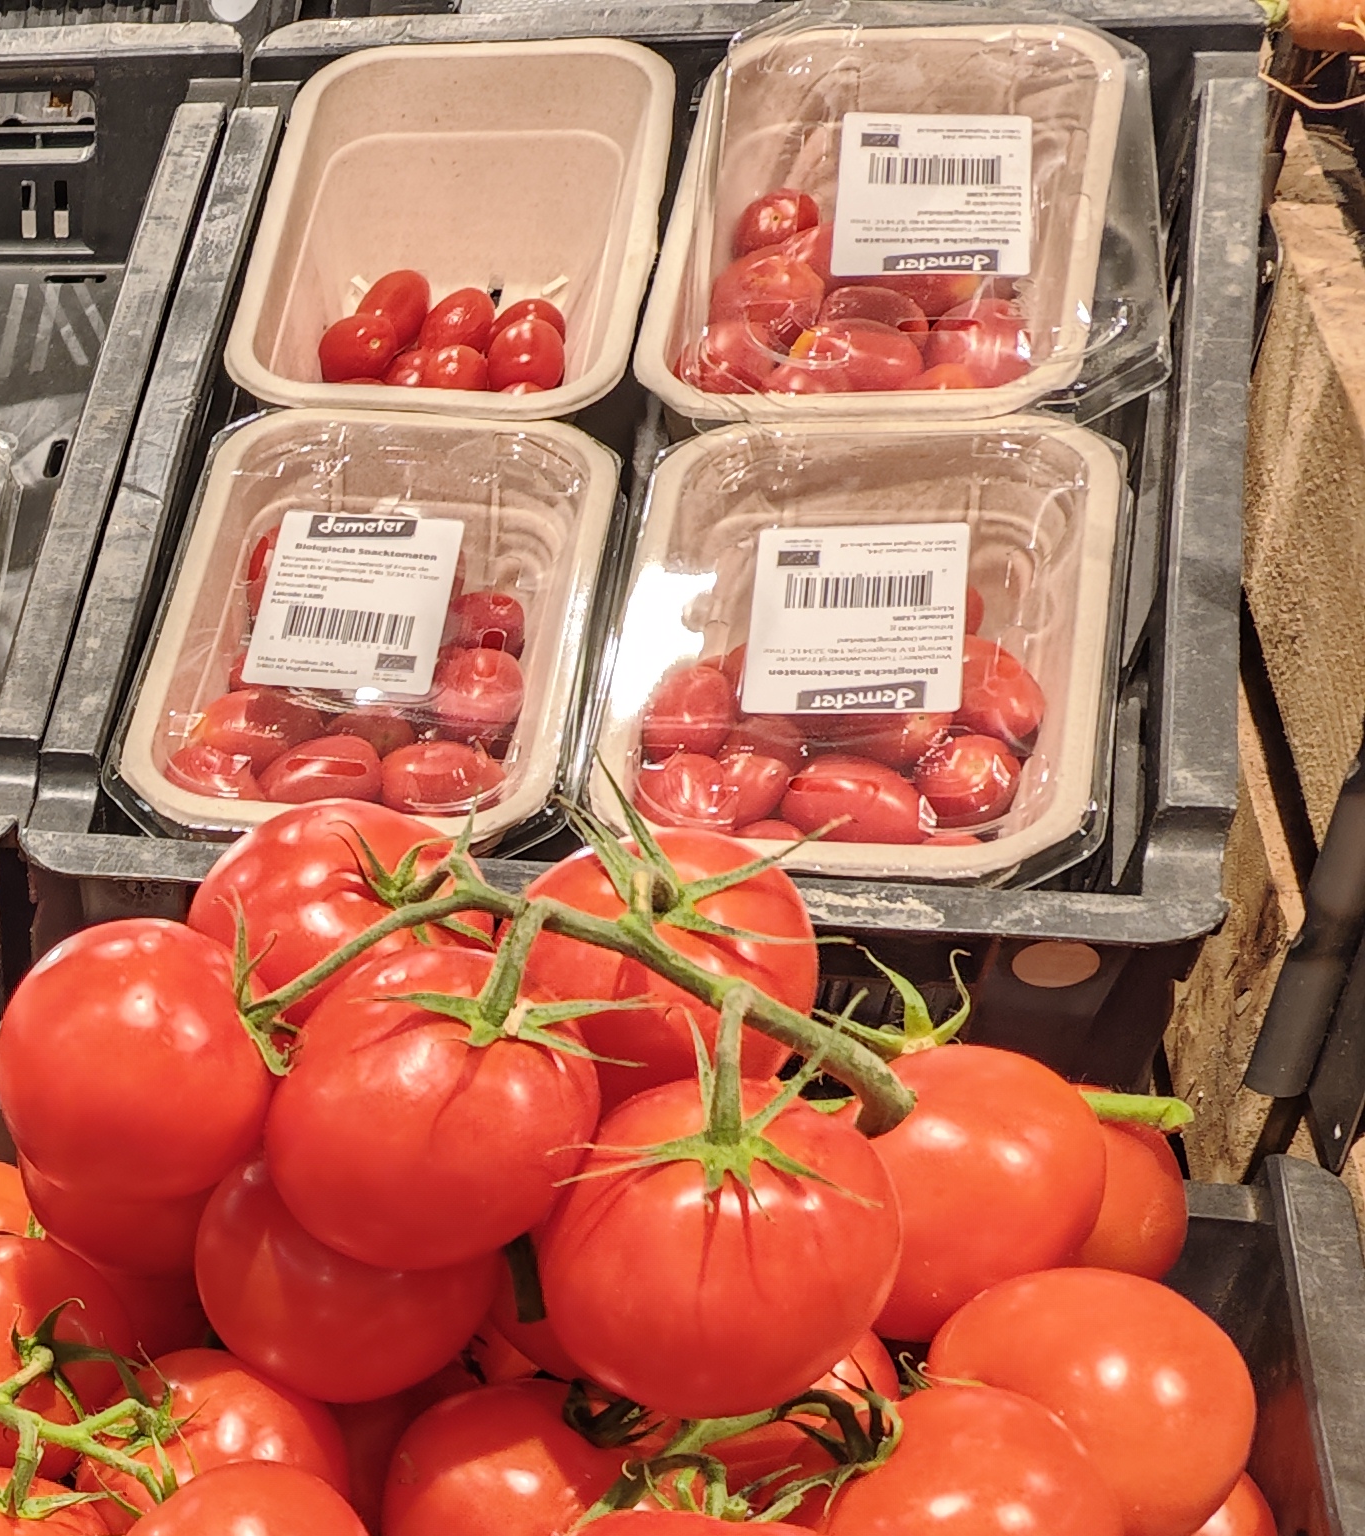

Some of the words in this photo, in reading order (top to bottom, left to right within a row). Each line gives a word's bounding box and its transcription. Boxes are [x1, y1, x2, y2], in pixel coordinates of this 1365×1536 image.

[895, 254, 990, 271] demeter
[318, 516, 406, 534] demeter
[294, 542, 356, 554] Biologische
[357, 548, 437, 560] Snacktomaten
[768, 668, 861, 676] Snacktomaten
[863, 666, 937, 675] Biologische
[810, 687, 915, 710] demeter
